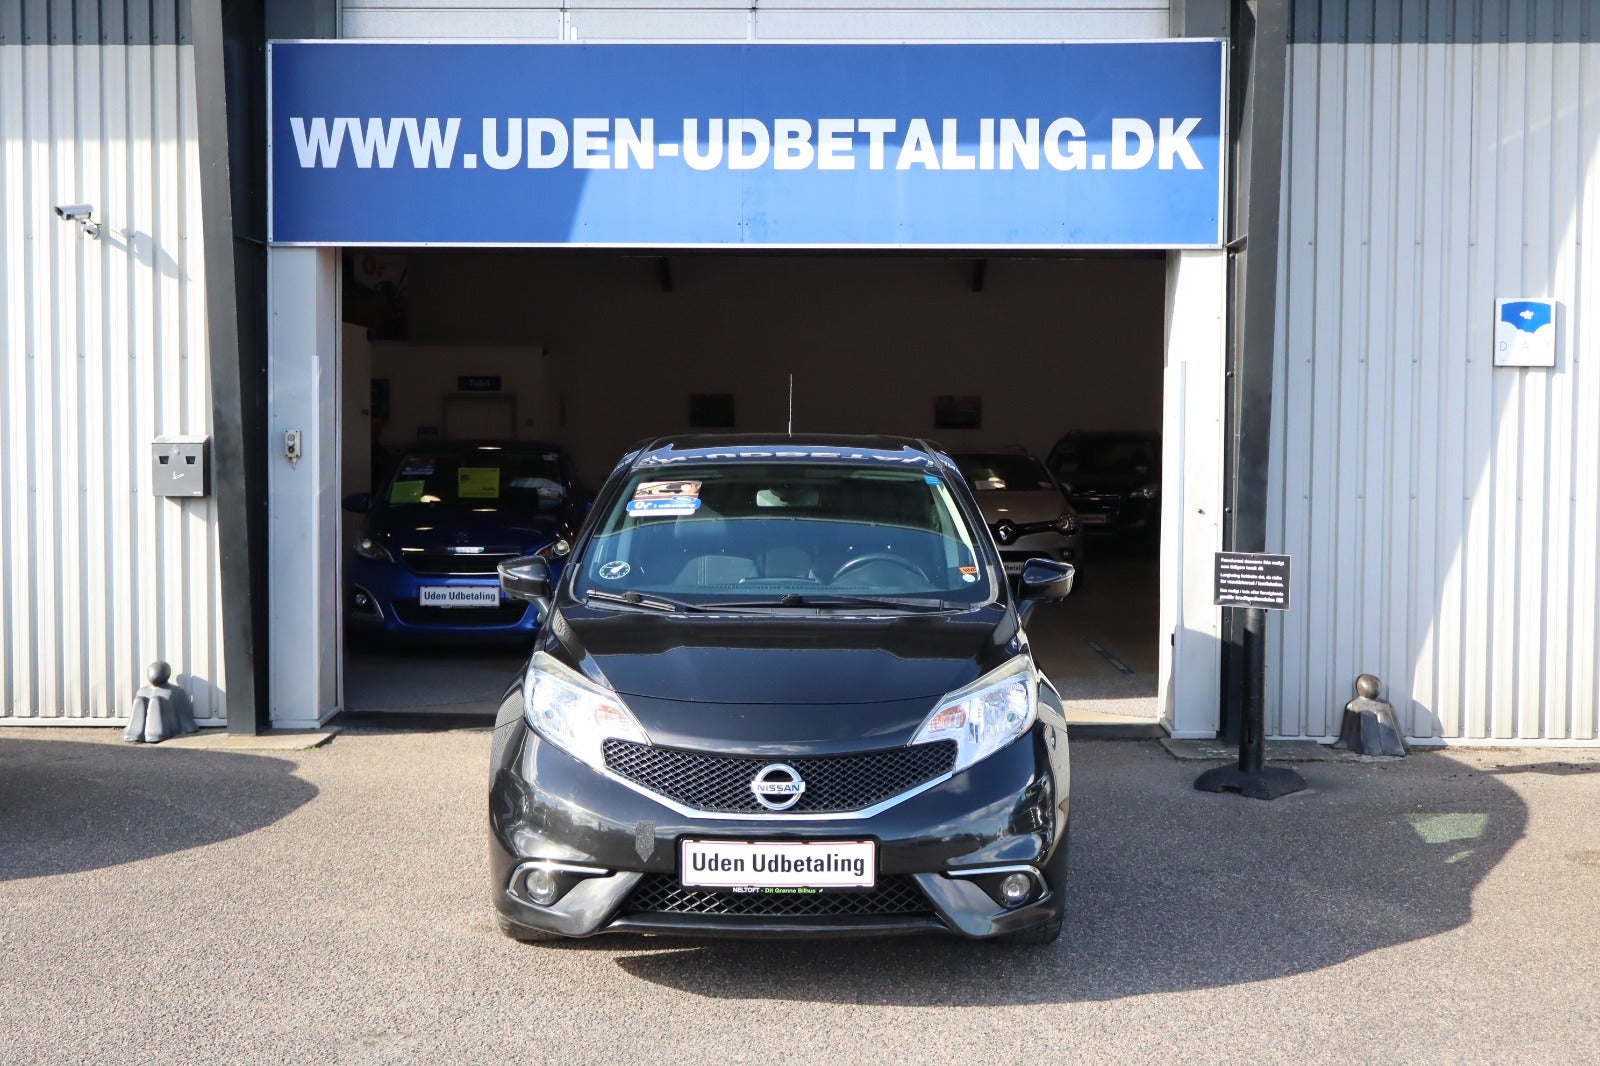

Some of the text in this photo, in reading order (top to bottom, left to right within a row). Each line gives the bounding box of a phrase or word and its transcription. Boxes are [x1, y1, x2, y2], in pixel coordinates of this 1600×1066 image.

[290, 117, 1204, 170] WWW.UDEN-UDBETALING.DK
[424, 591, 496, 602] Uden Udbetaling
[757, 784, 800, 792] NISSAN
[693, 853, 865, 876] Uden Udbetaling
